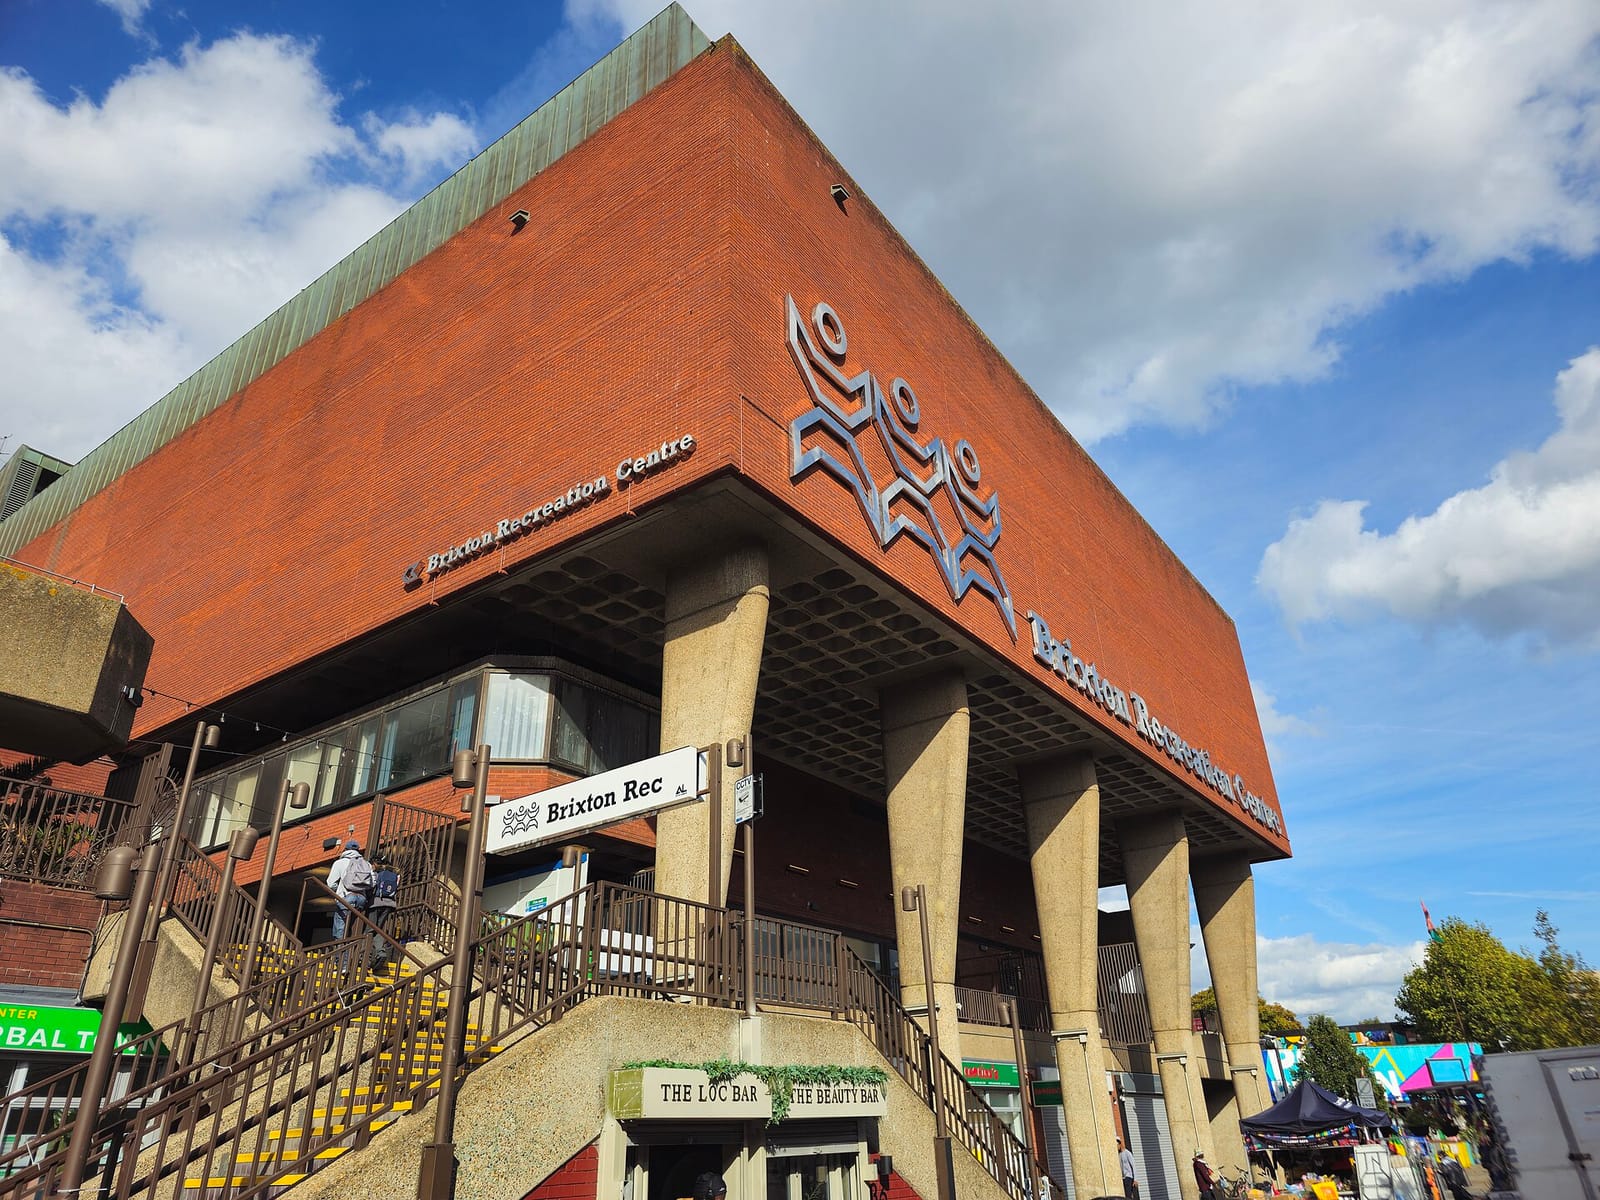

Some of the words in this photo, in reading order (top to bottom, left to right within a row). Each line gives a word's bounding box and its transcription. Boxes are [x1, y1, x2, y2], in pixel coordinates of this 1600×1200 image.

[427, 532, 495, 573] Brixton
[495, 474, 609, 541] Recreation
[616, 432, 695, 481] Centre
[1026, 609, 1133, 724] Brixton
[1129, 690, 1235, 801] Recreation
[1233, 773, 1282, 836] Centre
[736, 776, 752, 790] CCTV
[546, 790, 617, 824] Brixton
[622, 777, 664, 803] Rec
[661, 1083, 692, 1102] THE
[698, 1084, 728, 1102] LOC
[733, 1085, 758, 1102] BAR
[790, 1088, 813, 1104] THE
[818, 1088, 858, 1104] BEAUTY
[861, 1088, 879, 1103] BAR
